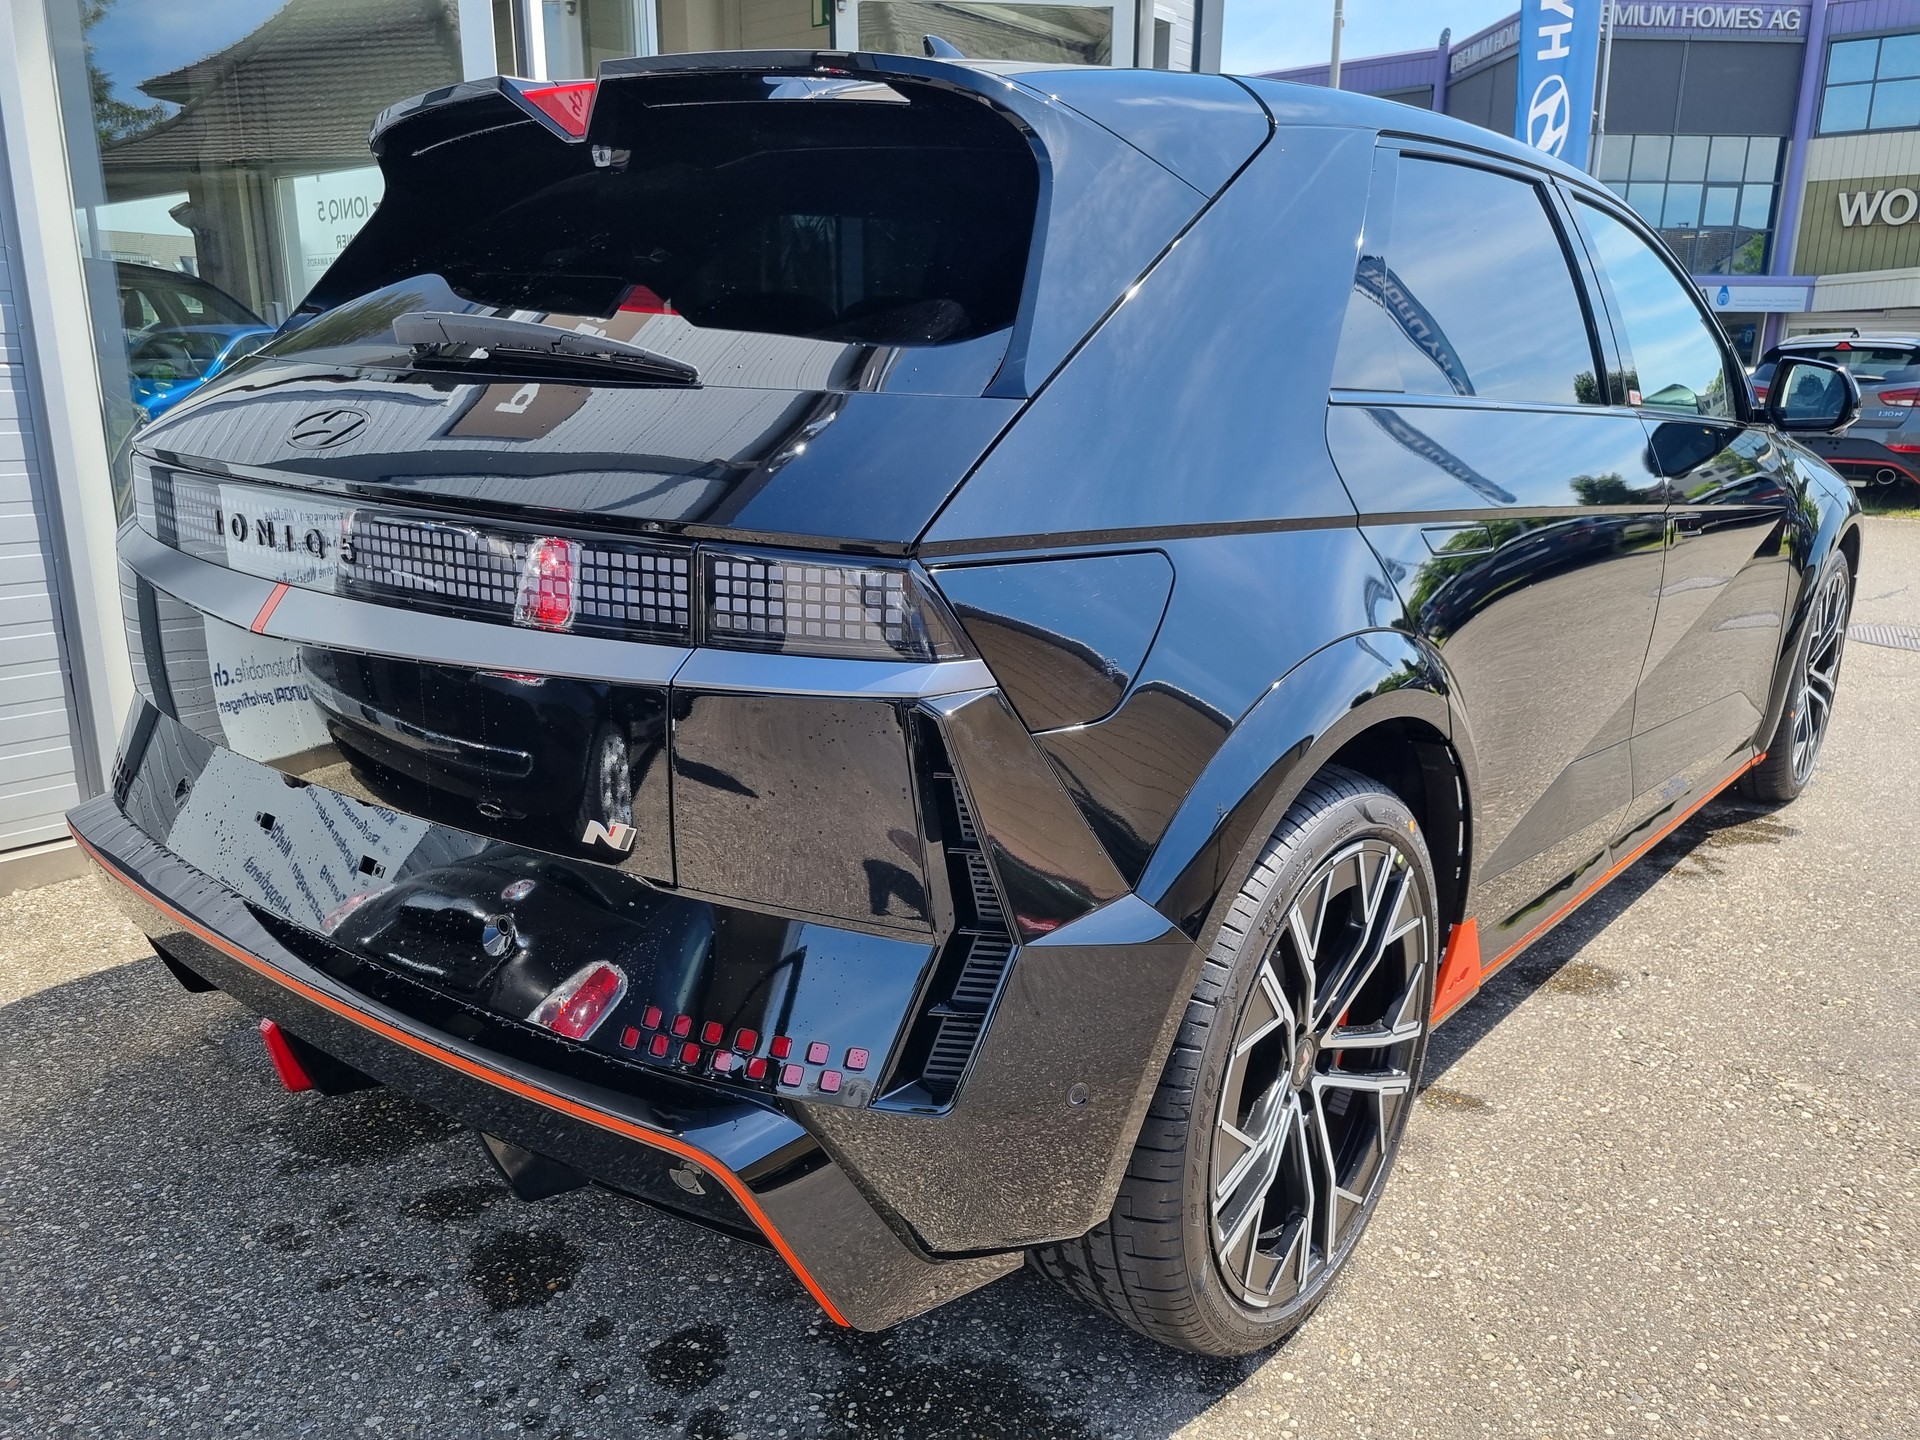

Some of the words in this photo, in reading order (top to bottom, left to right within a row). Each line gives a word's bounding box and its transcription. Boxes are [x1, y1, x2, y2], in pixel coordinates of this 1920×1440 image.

[1680, 6, 1763, 29] HOMES
[1766, 9, 1801, 30] AG
[1838, 188, 1920, 227] WO
[215, 510, 326, 560] IONIQ
[340, 537, 358, 565] 5
